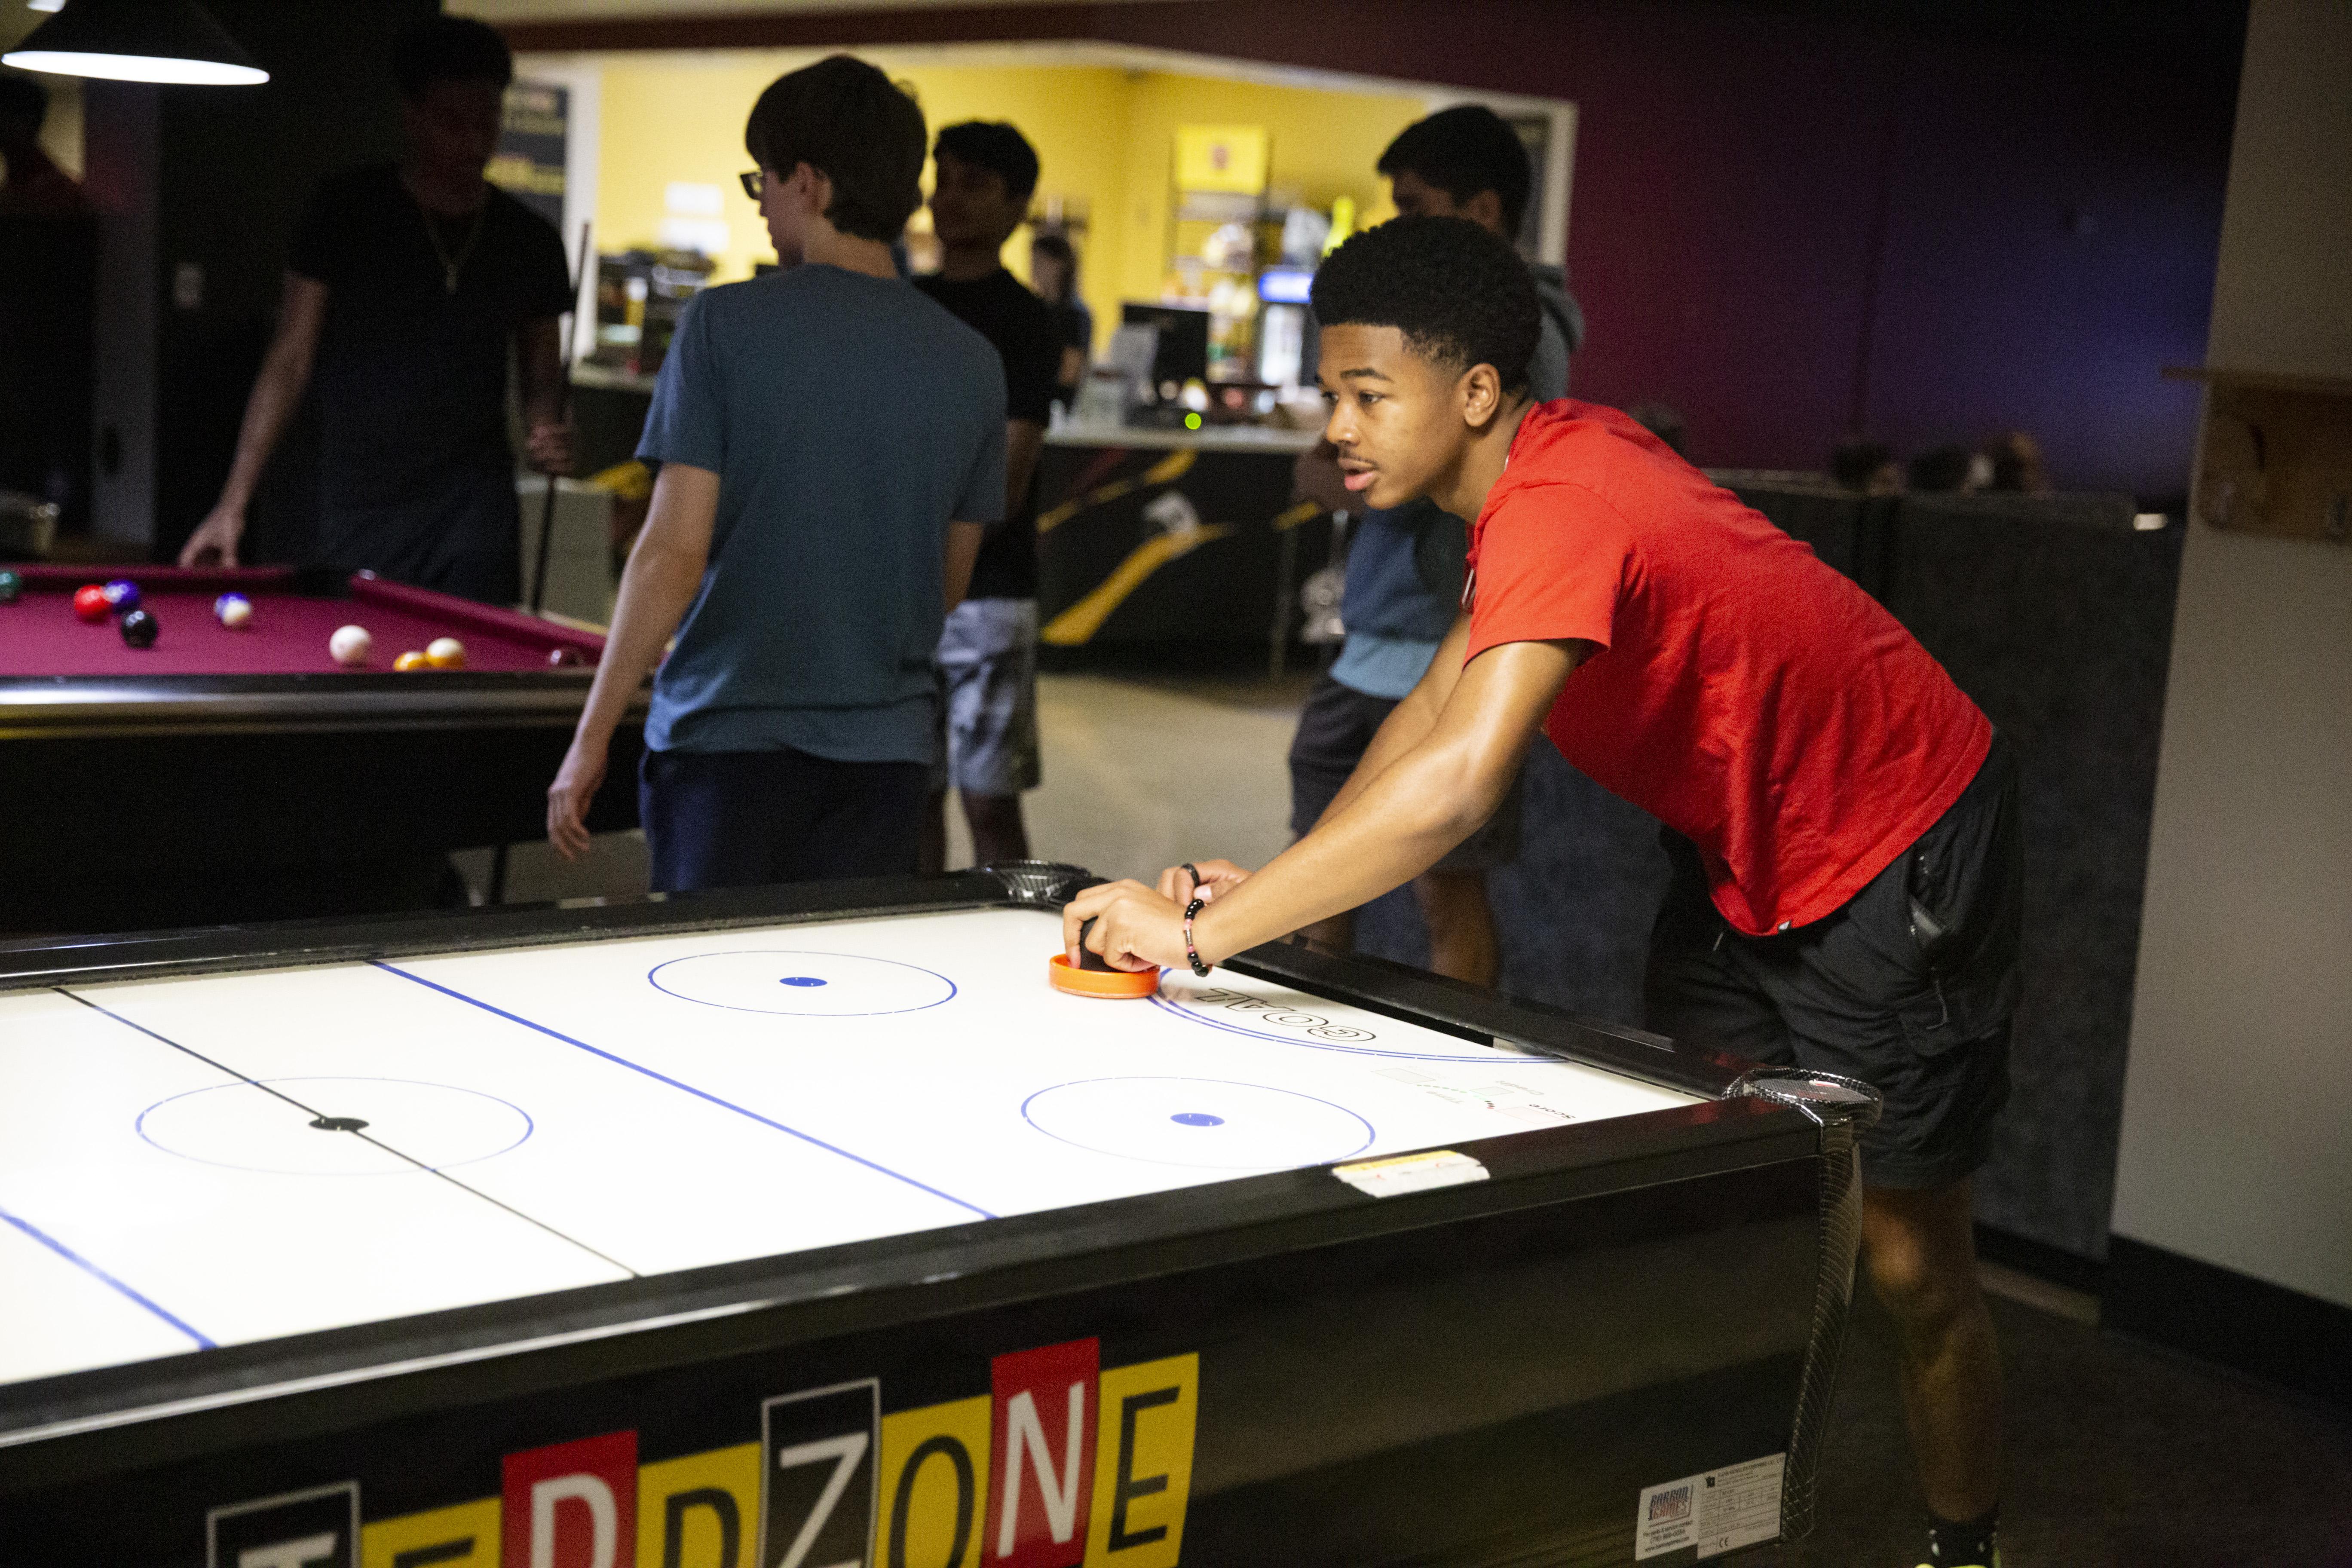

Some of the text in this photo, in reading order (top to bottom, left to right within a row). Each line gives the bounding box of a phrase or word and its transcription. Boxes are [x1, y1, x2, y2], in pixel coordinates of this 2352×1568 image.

[1194, 988, 1376, 1041] GOAL
[1529, 1103, 1577, 1120] Score
[1651, 1486, 1688, 1507] BARRON
